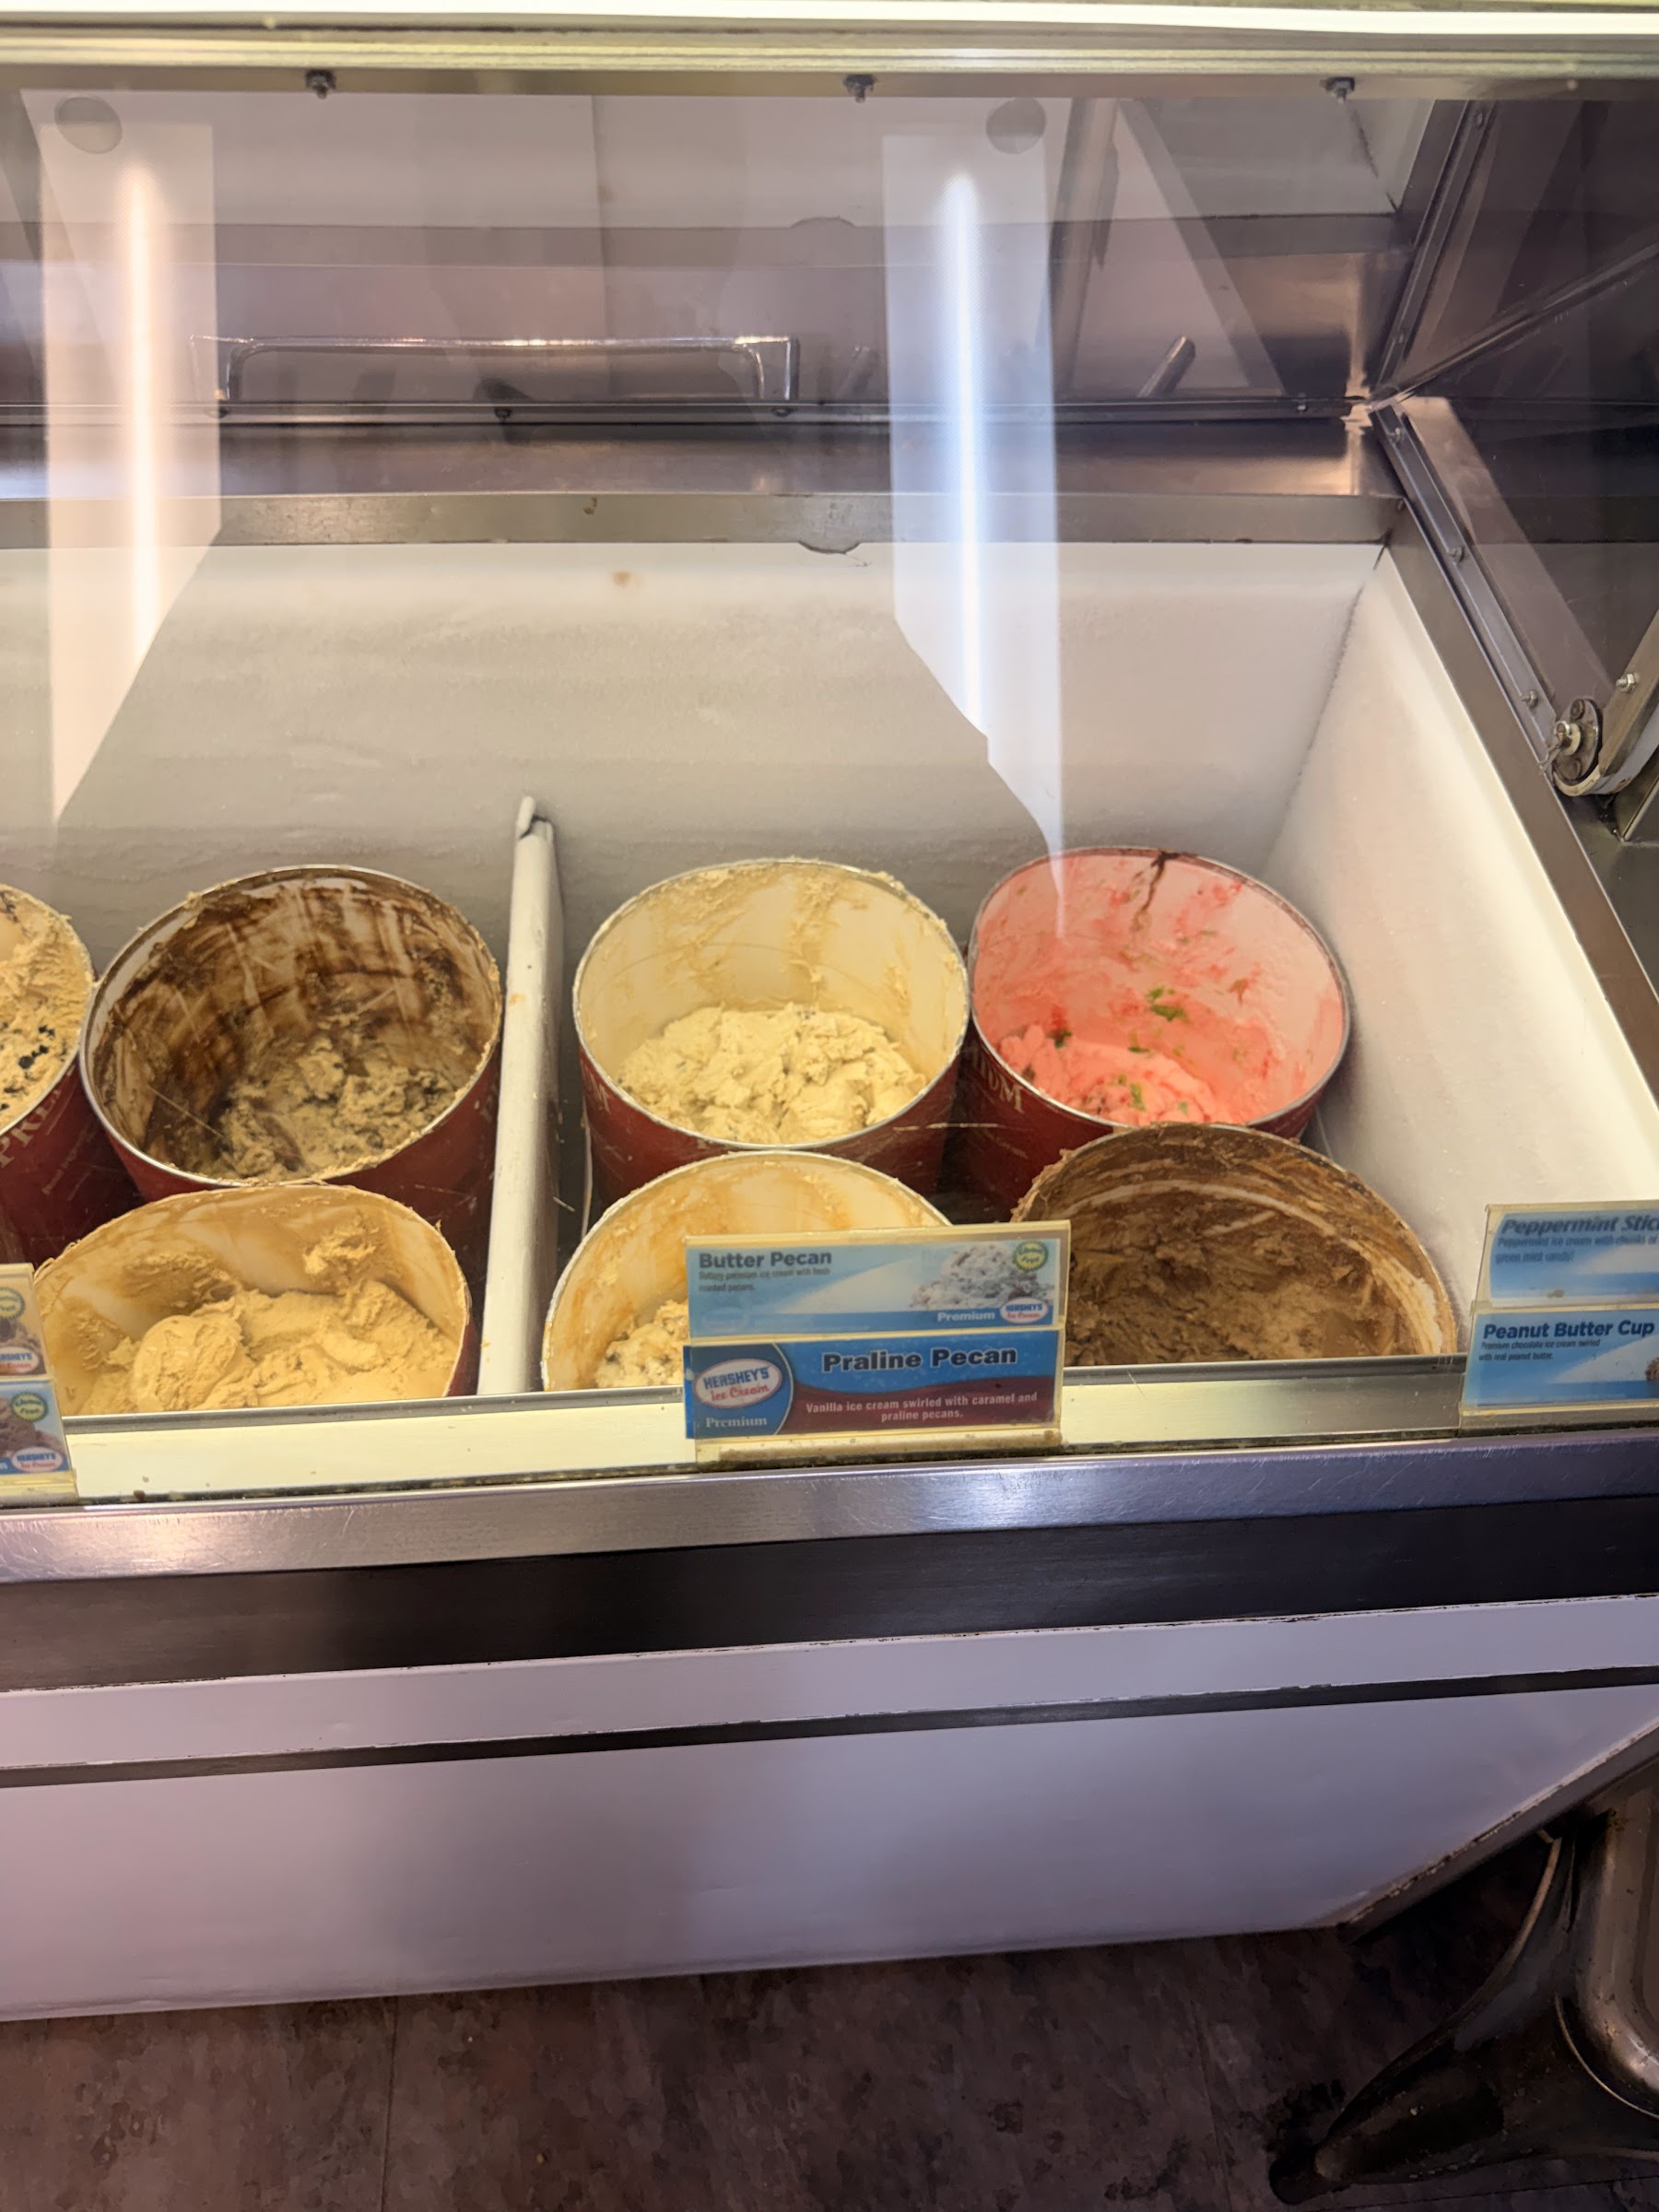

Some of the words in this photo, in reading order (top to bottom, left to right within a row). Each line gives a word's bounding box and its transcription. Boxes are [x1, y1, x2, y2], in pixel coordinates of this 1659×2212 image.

[1501, 1218, 1619, 1235] Peppermint
[1621, 1215, 1659, 1231] Stic
[699, 1253, 765, 1268] Butter
[770, 1252, 832, 1266] Pecan
[937, 1311, 995, 1323] Premium
[1483, 1323, 1550, 1339] Peanut
[1554, 1321, 1614, 1337] Butter
[1618, 1319, 1655, 1337] Cup
[822, 1349, 922, 1373] Praline
[930, 1347, 1018, 1369] Pecan
[703, 1365, 770, 1390] HERSHEY'S
[729, 1384, 770, 1398] Cream
[806, 1402, 843, 1414] Vanilla
[846, 1400, 863, 1411] ice
[865, 1400, 900, 1410] cream
[902, 1396, 942, 1409] swirled
[945, 1394, 969, 1406] with
[971, 1394, 1015, 1406] caramel
[1018, 1392, 1038, 1403] and
[705, 1417, 768, 1428] Premium
[881, 1410, 919, 1423] praline
[923, 1409, 964, 1421] pecans.
